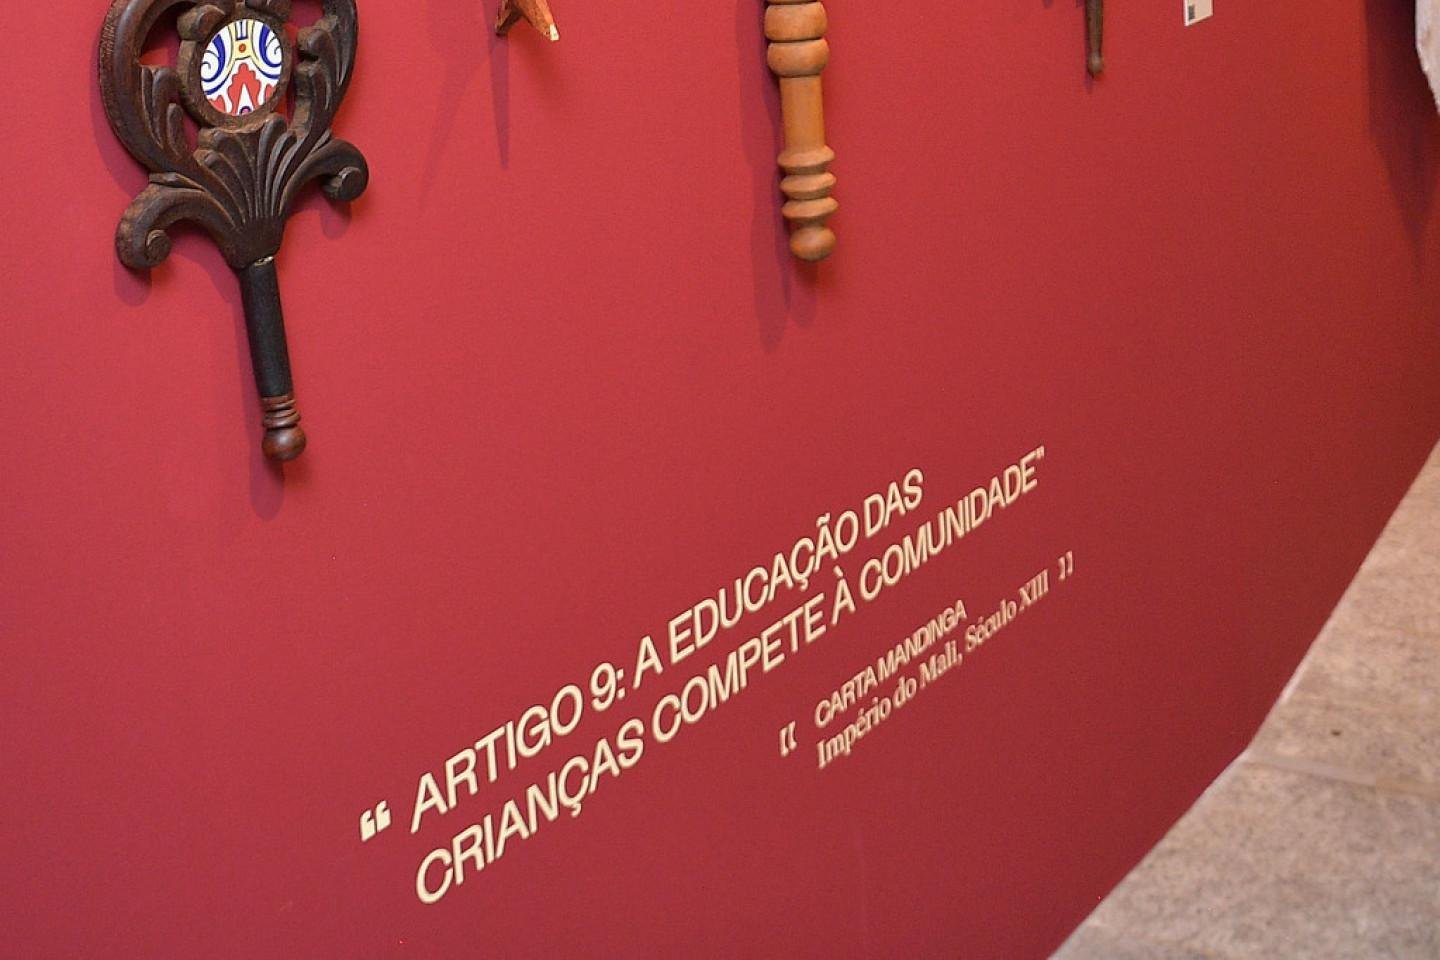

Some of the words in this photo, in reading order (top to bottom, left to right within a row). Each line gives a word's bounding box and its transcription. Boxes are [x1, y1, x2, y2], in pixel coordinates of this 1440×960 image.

[410, 684, 583, 834] ARTIGO
[589, 662, 626, 712] 9:
[632, 635, 663, 690] A
[668, 510, 859, 665] EDUCAÇÃO
[863, 468, 924, 538] DAS
[416, 718, 645, 905] CRIANÇAS
[652, 593, 827, 743] COMPETE
[831, 565, 856, 626] À
[814, 666, 878, 728] CARTA
[877, 599, 968, 683] MANDINGA
[816, 696, 892, 769] Império
[893, 676, 918, 709] do
[919, 640, 964, 689] Mali,
[964, 599, 1017, 653] Século
[1019, 569, 1050, 612] XIII
